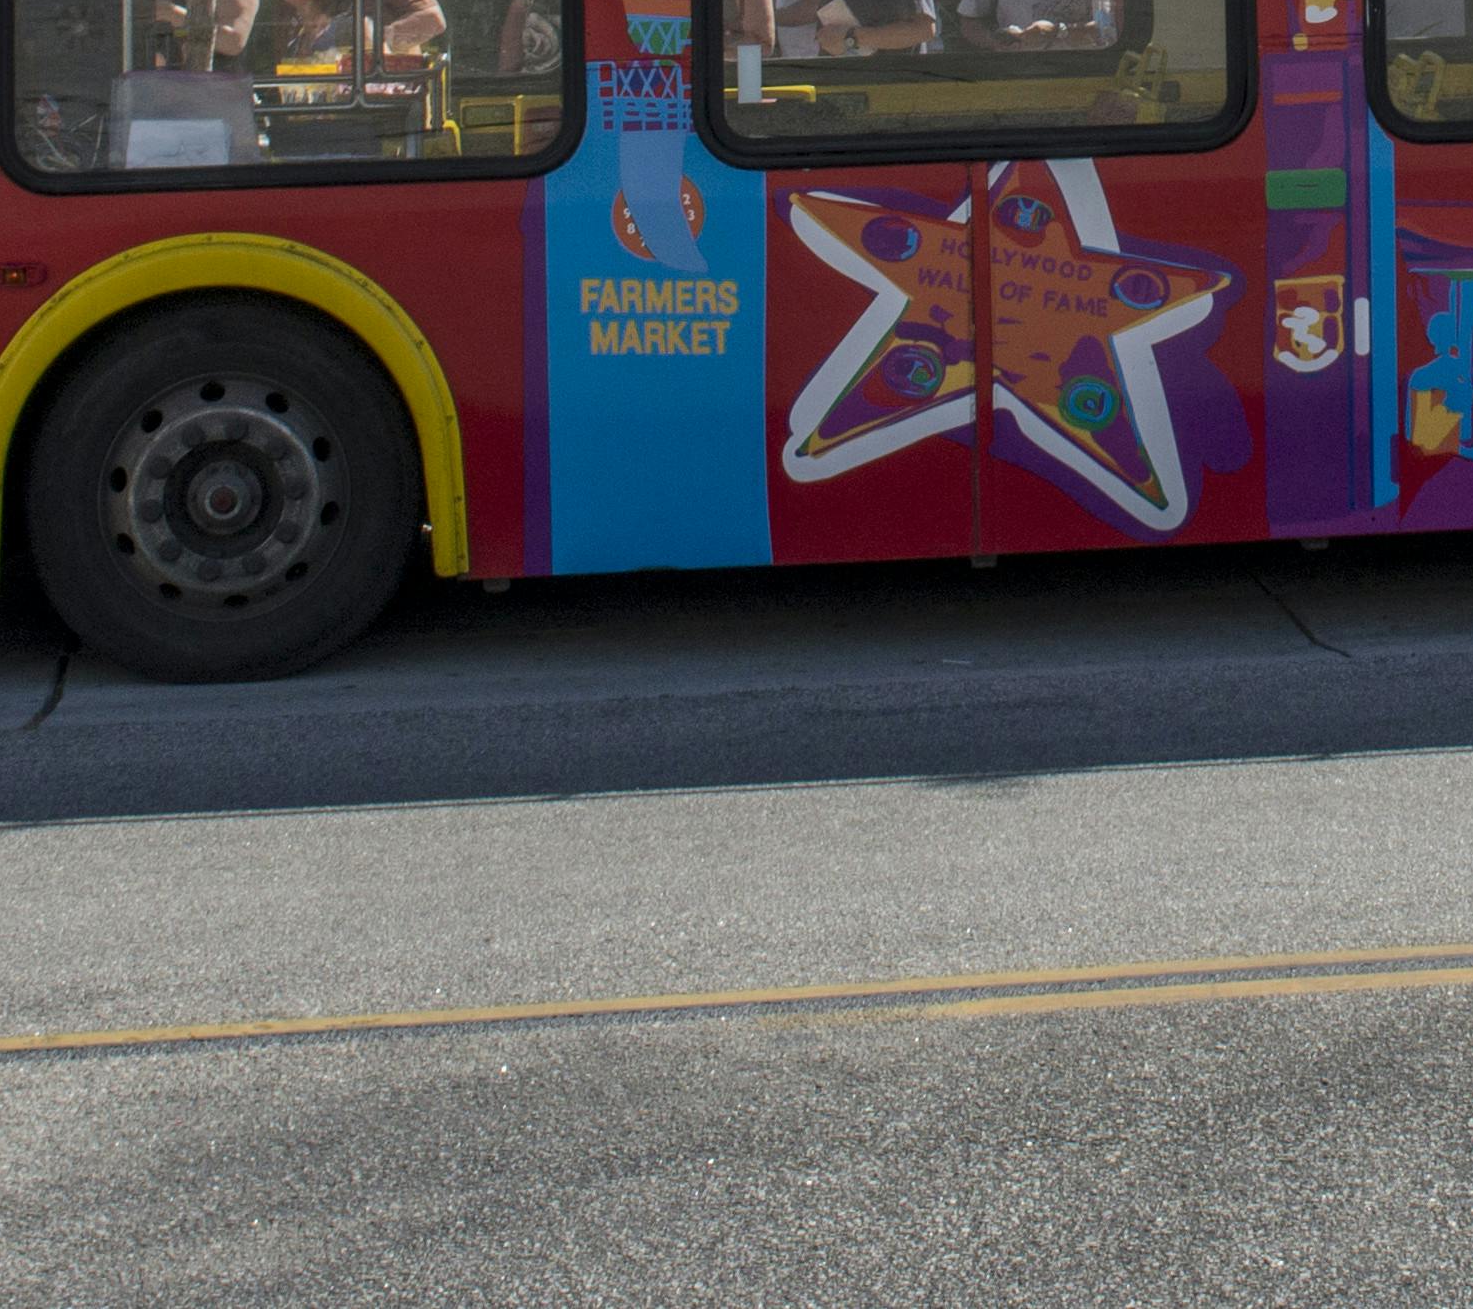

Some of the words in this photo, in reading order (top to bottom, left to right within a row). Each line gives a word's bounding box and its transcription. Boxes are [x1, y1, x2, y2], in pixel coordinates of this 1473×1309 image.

[941, 237, 1093, 282] HOLYWOOD
[580, 278, 740, 315] FARMERS
[918, 266, 970, 294] WAL
[999, 281, 1032, 303] OF
[1043, 290, 1109, 318] FAME
[590, 319, 731, 355] MARKET
